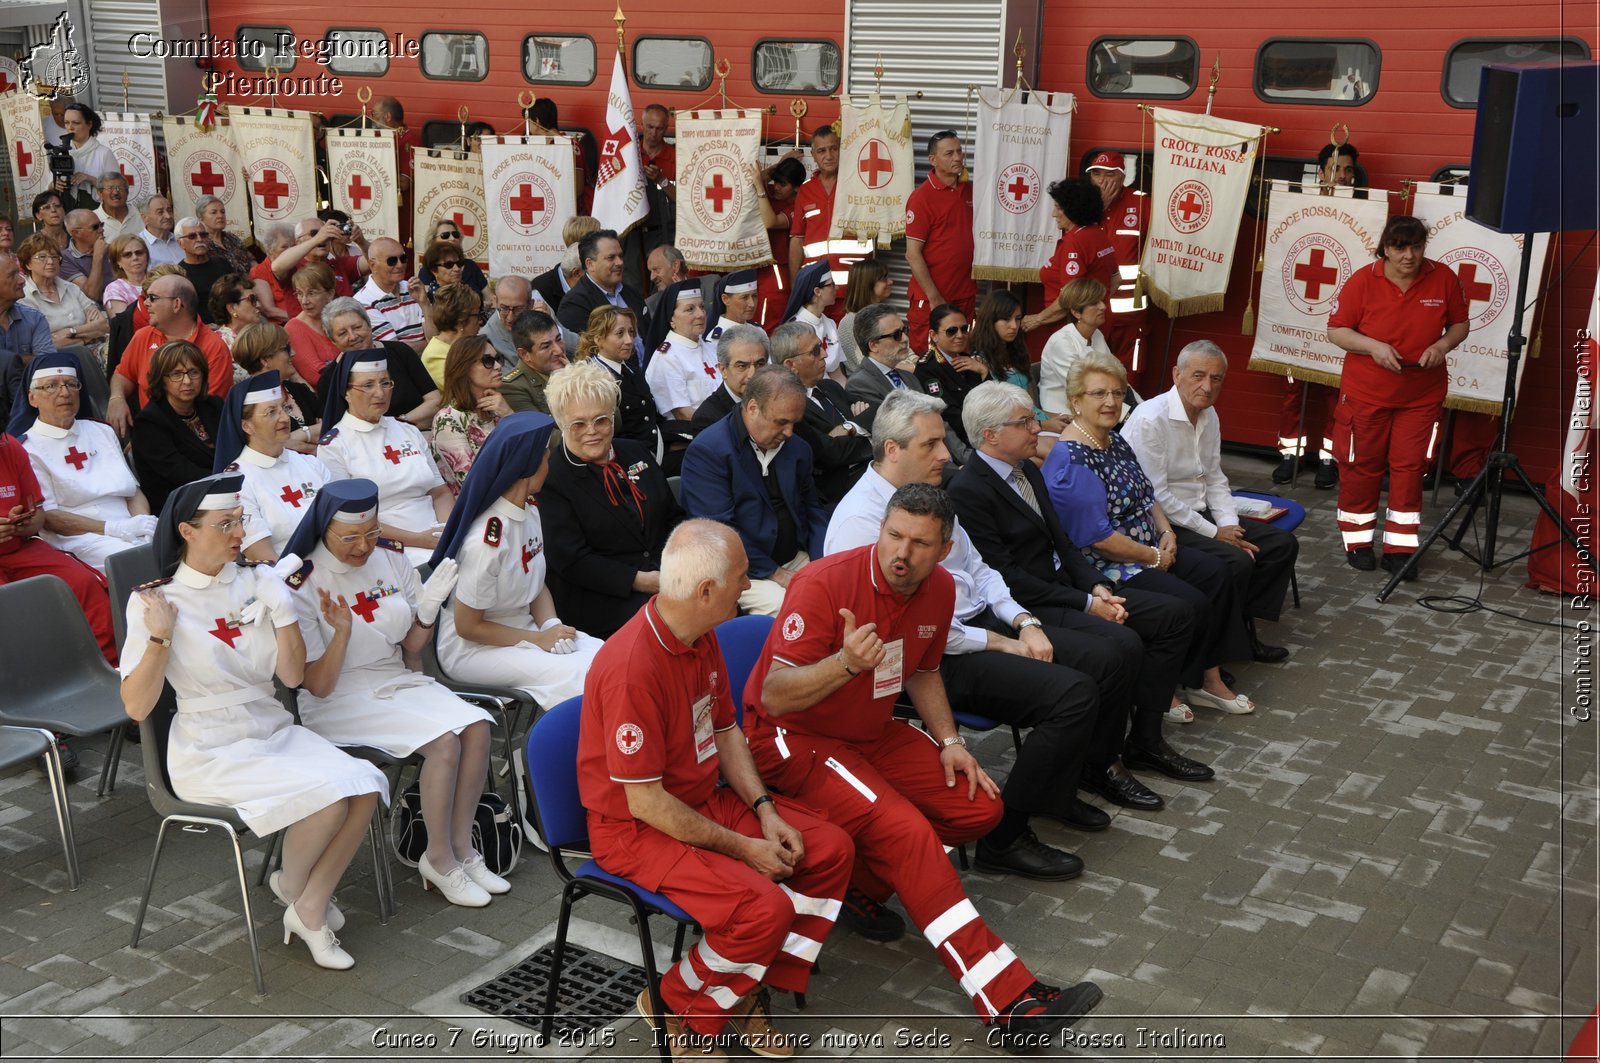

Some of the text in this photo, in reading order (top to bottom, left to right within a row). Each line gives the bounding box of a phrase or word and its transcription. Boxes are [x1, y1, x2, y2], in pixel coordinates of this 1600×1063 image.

[608, 92, 636, 128] ROUGE
[724, 129, 733, 137] DEL
[992, 122, 1023, 133] CROCE
[169, 137, 187, 157] CROCE
[255, 136, 278, 146] ROSSA
[1002, 134, 1043, 146] ITALIANA
[1161, 136, 1246, 164] CROCE ROSSA
[367, 154, 392, 188] ITALIANA
[491, 153, 562, 180] CROCE ROSSA ITALIANA
[680, 140, 754, 187] CROCE ROSSA ITALIANA
[1170, 153, 1228, 176] ITALIANA
[417, 180, 469, 214] CROCE ROSSA
[1269, 206, 1378, 256] CROCE ROSSA ITALIANA
[1425, 216, 1452, 243] ROCE
[496, 244, 566, 252] COMITATO LOCALE
[679, 236, 765, 251] GRUPPO DI MELLE
[993, 242, 1036, 252] TRECATE
[1151, 237, 1225, 264] OMITATO LOCALE
[723, 249, 766, 263] LOCALE
[1157, 252, 1205, 273] DI CANELLI
[511, 266, 551, 274] DRONERO
[1284, 245, 1300, 300] CONVENZIONE
[1299, 239, 1306, 249] DI
[1307, 235, 1336, 250] GINEVRA
[1334, 246, 1344, 257] 22
[1445, 250, 1507, 324] DI GINEVRA 22 AGOSTO 1864
[1271, 324, 1331, 343] COMITATO LOC
[1270, 343, 1344, 366] LIMONE PIEMONTE
[1303, 341, 1311, 349] DI
[1463, 344, 1508, 359] LOCALE
[1447, 357, 1457, 368] DI
